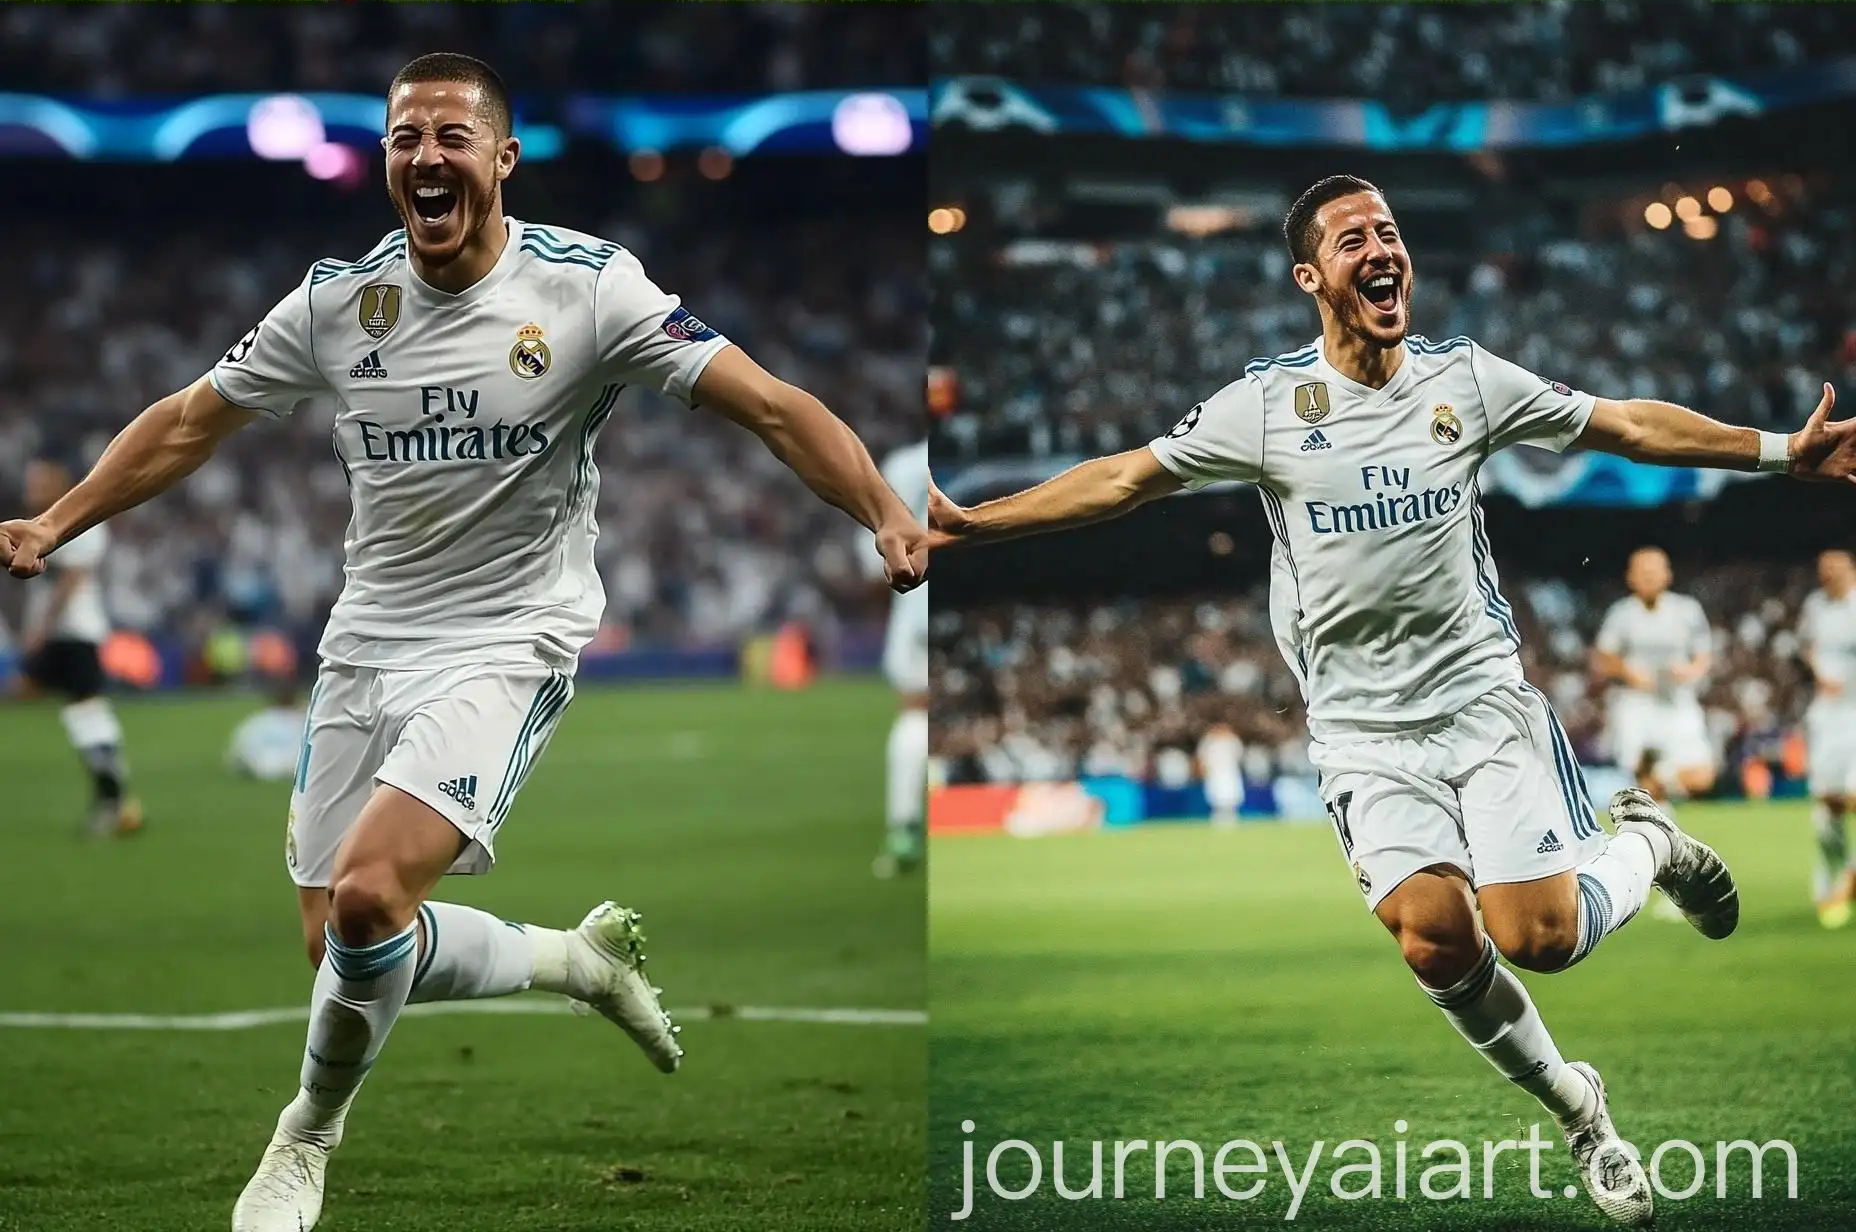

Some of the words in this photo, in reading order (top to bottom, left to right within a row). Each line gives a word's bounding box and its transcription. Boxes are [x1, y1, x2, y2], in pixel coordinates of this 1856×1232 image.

[420, 386, 479, 418] Fly
[360, 413, 549, 462] Emirates
[1361, 465, 1410, 490] Fly
[1305, 482, 1461, 533] Emirates
